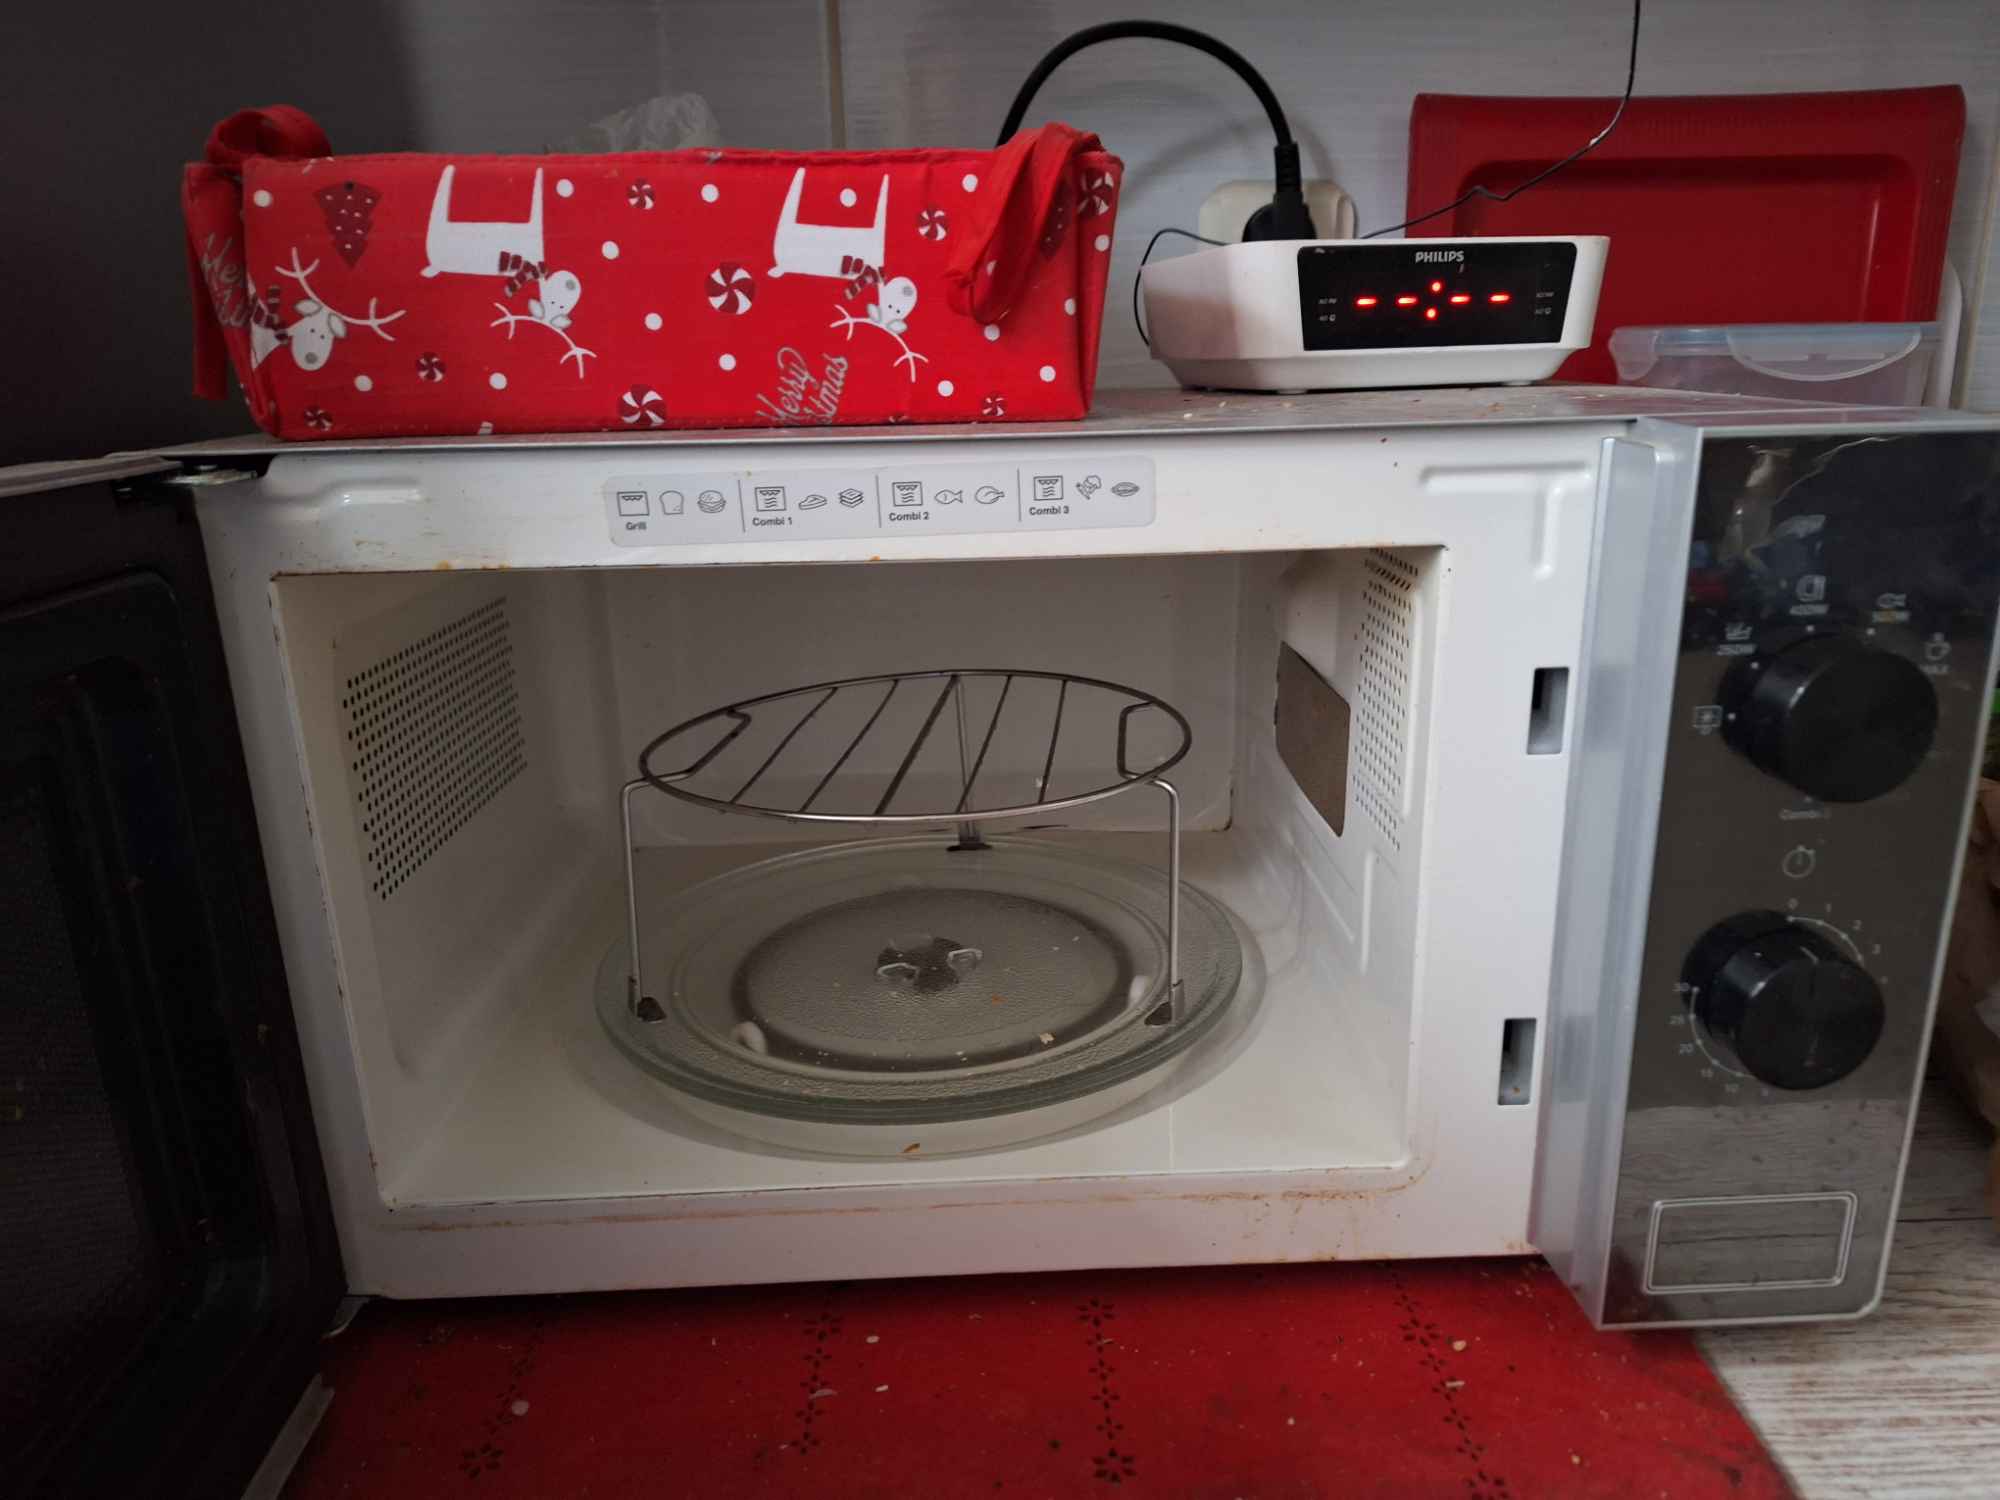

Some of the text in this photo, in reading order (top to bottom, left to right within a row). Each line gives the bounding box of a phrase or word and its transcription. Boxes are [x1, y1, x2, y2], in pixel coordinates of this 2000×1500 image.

[1415, 250, 1465, 263] PHILIPS
[1028, 505, 1070, 516] Combi 3
[752, 516, 785, 527] Combi
[888, 511, 930, 522] Combi 2
[625, 521, 647, 531] Grill
